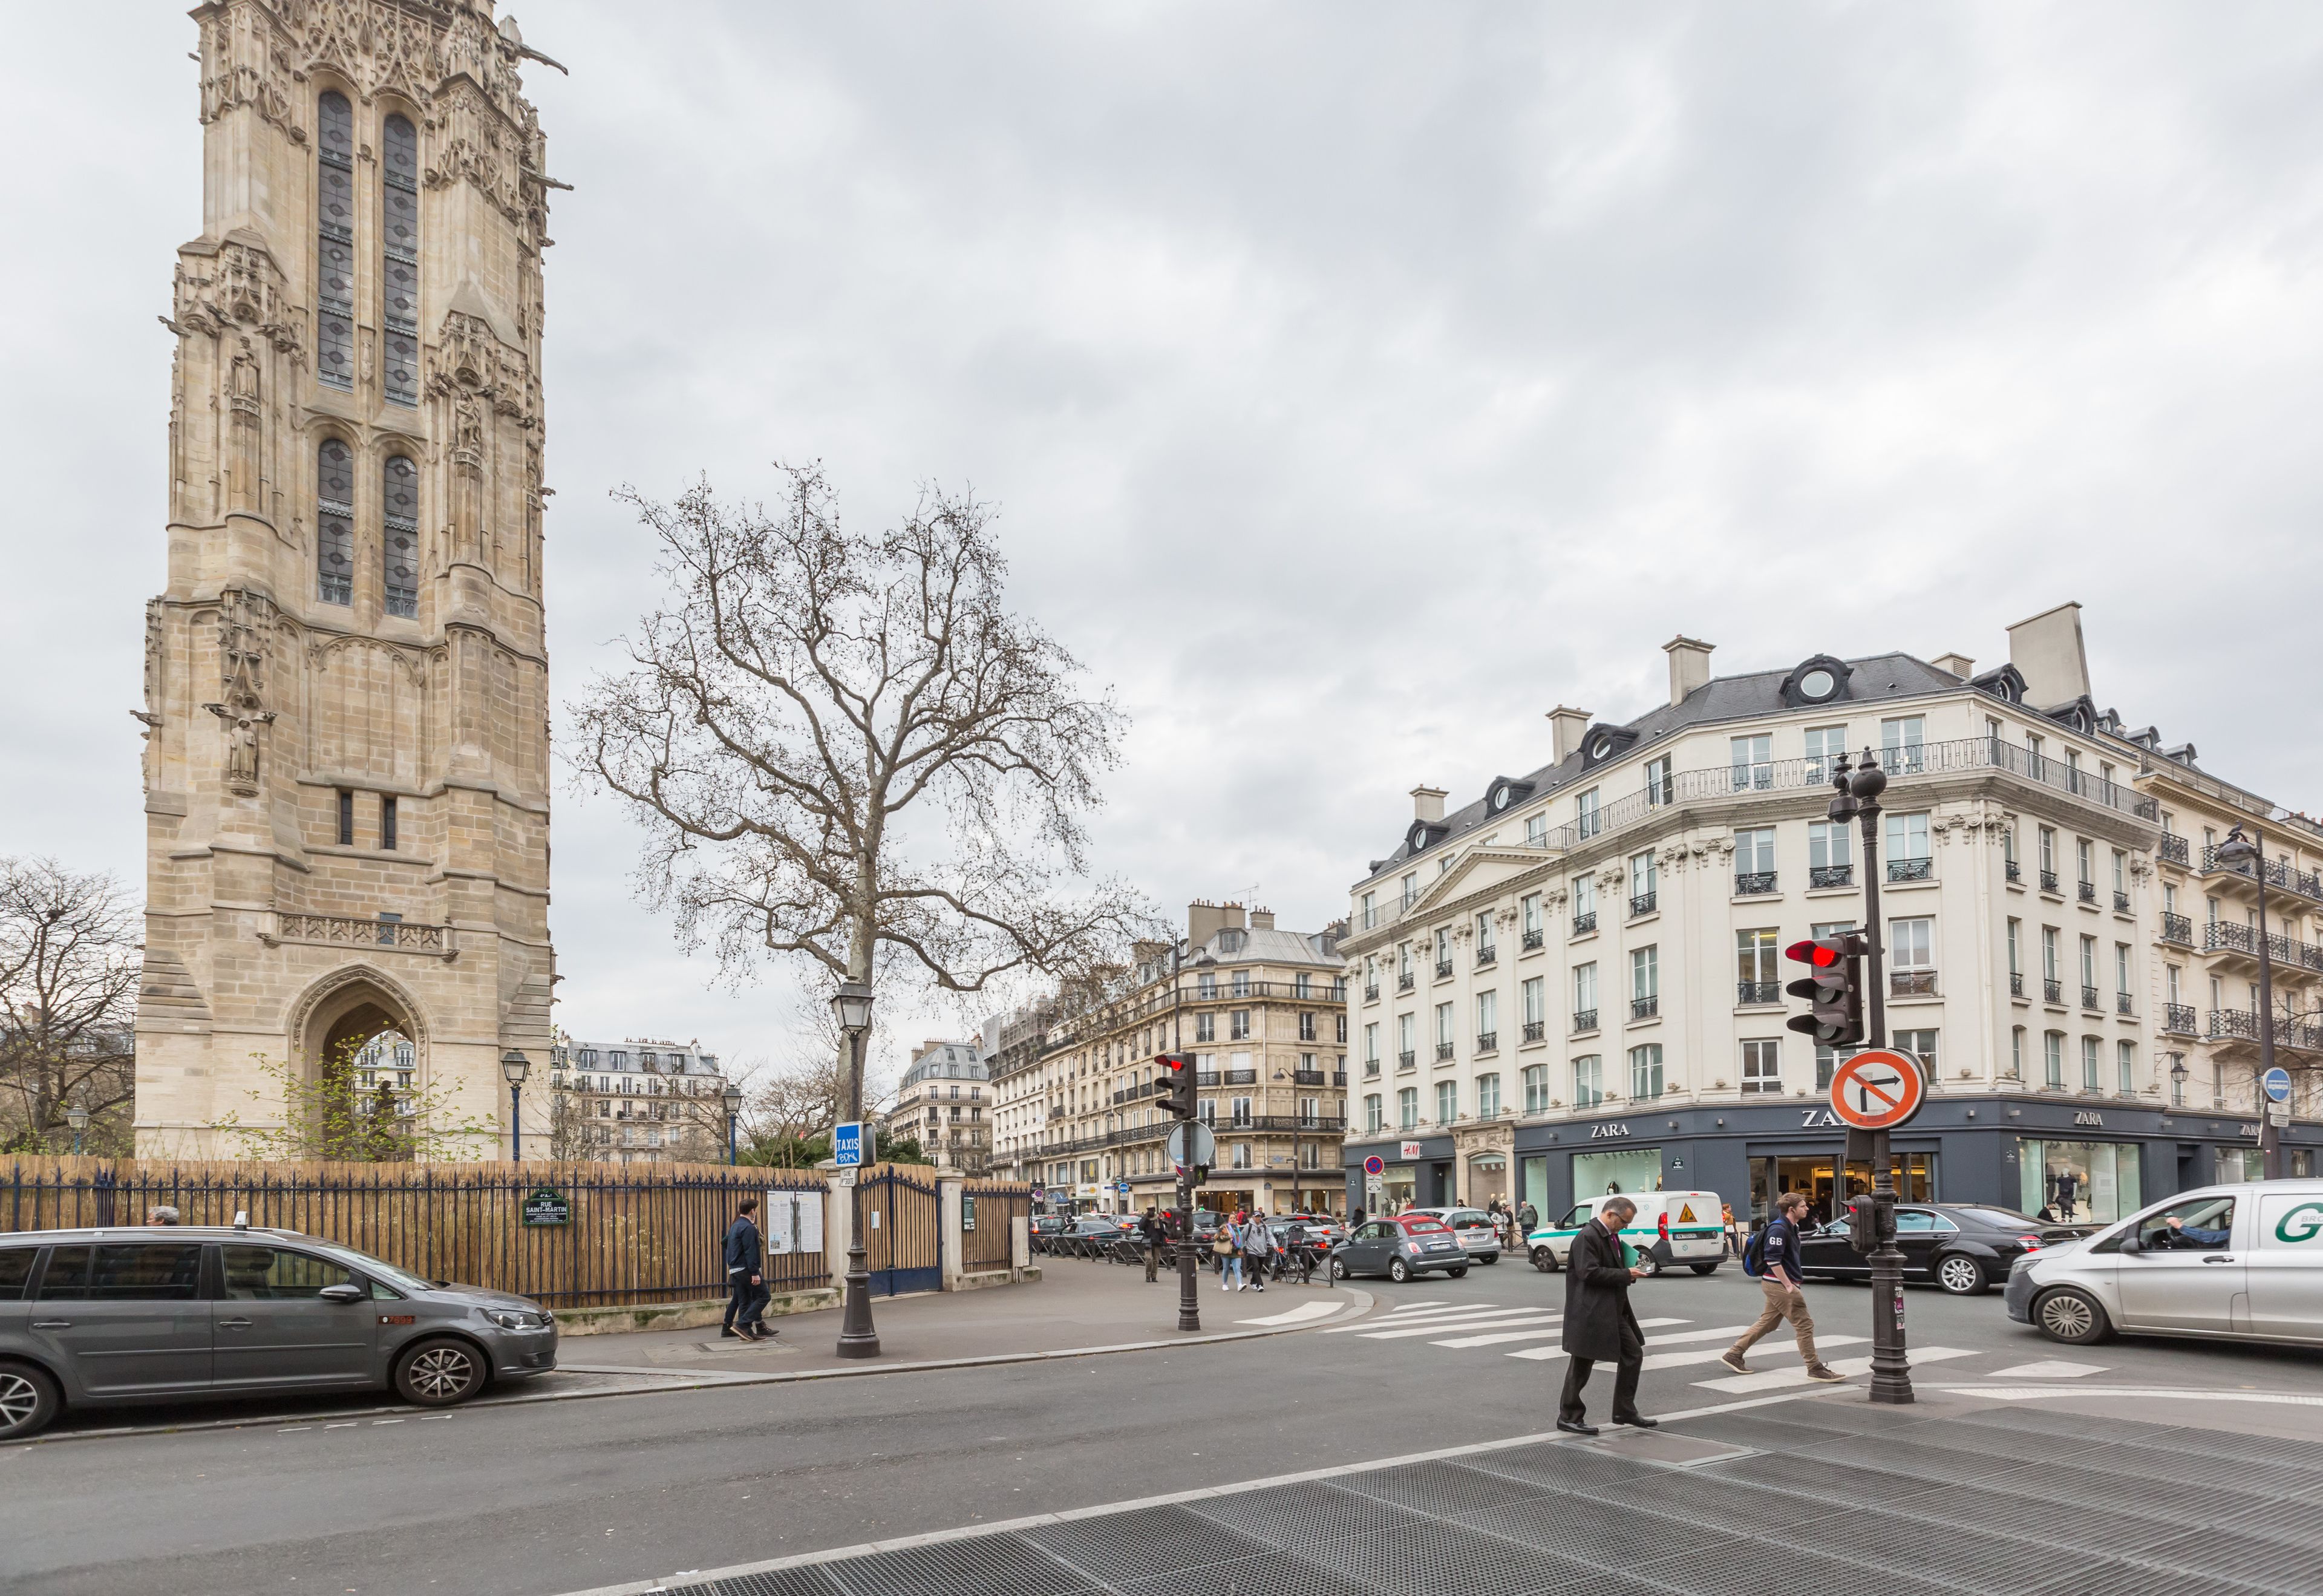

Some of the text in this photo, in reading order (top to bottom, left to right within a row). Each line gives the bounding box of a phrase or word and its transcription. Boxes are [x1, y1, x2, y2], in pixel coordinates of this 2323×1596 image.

[1802, 1111, 1848, 1127] ZA
[2074, 1111, 2103, 1125] ZARA
[1591, 1123, 1630, 1138] ZARA
[837, 1138, 859, 1151] TAXIS
[1404, 1145, 1419, 1156] H&M
[1769, 1237, 1782, 1245] GB
